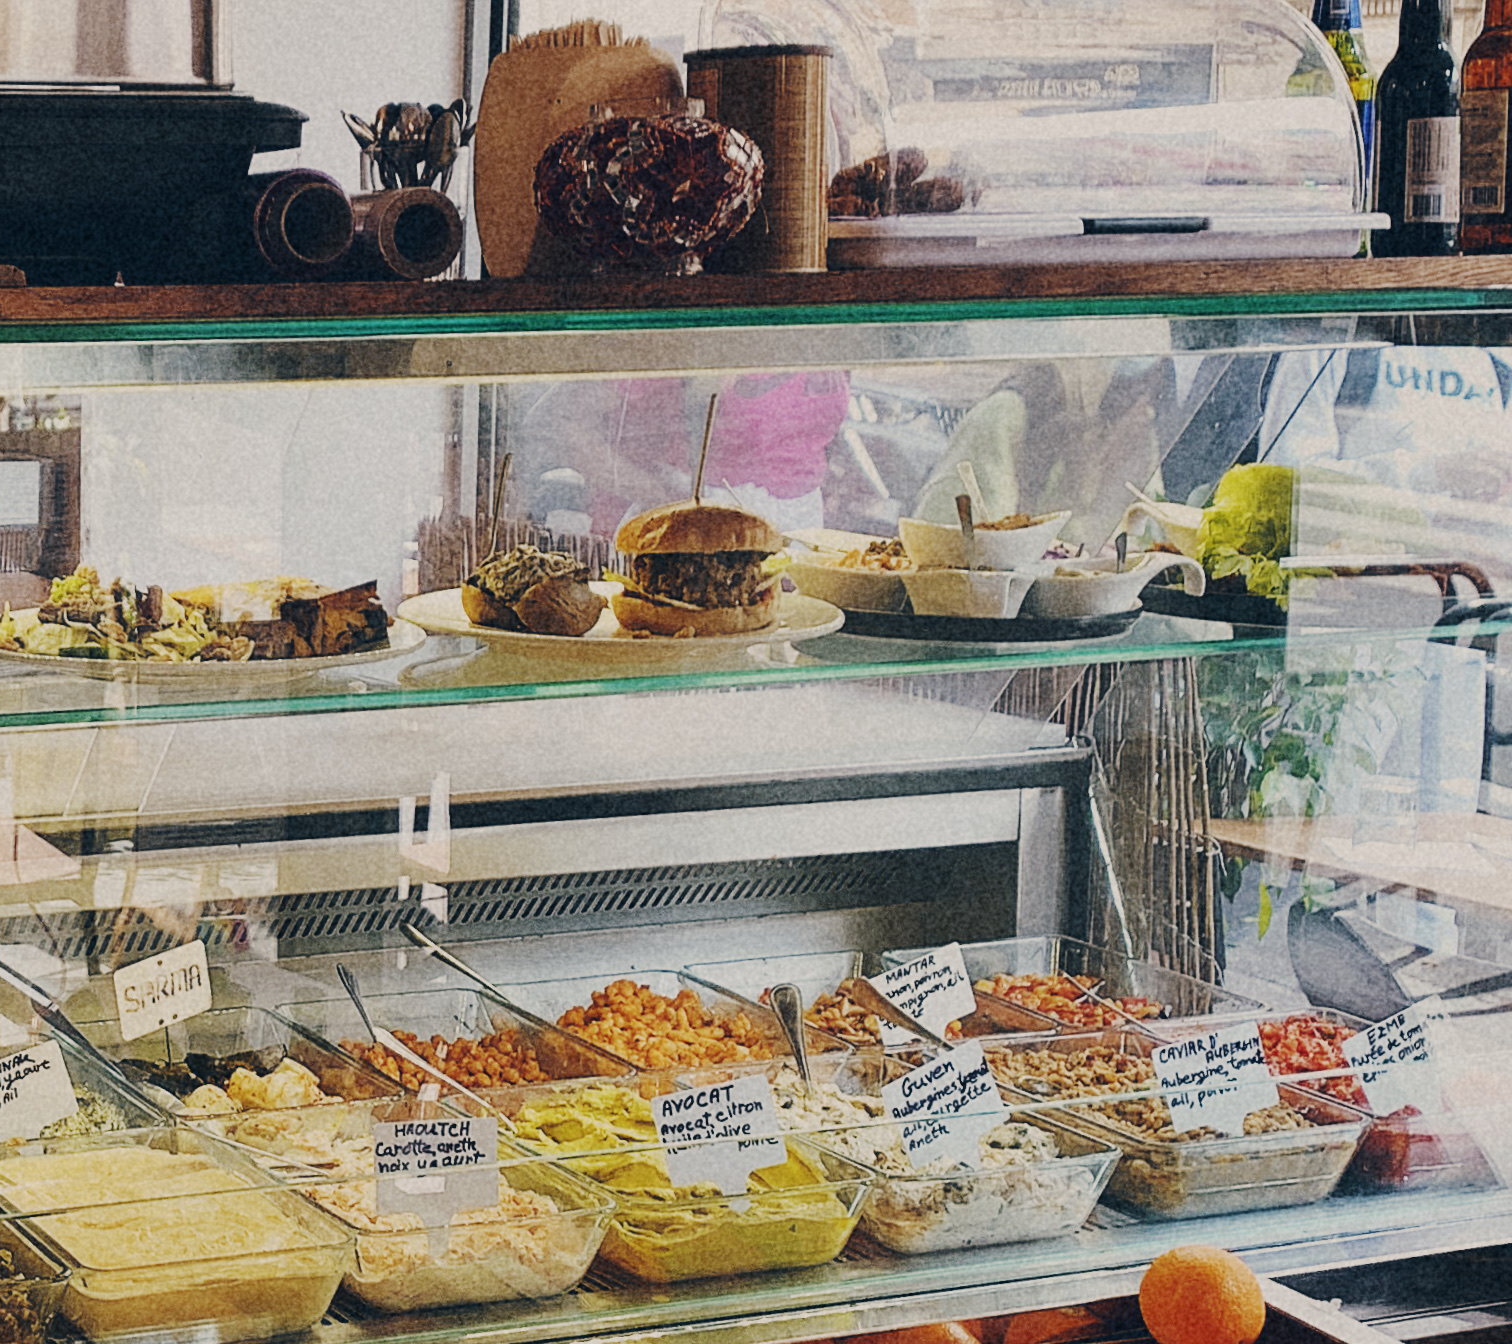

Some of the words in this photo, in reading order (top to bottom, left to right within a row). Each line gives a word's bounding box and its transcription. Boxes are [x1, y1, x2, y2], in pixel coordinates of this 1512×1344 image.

[885, 955, 936, 984] MANTAR
[124, 964, 202, 1013] SARMA
[1159, 1039, 1207, 1064] CAVIAR
[662, 1084, 734, 1117] AVOCAT
